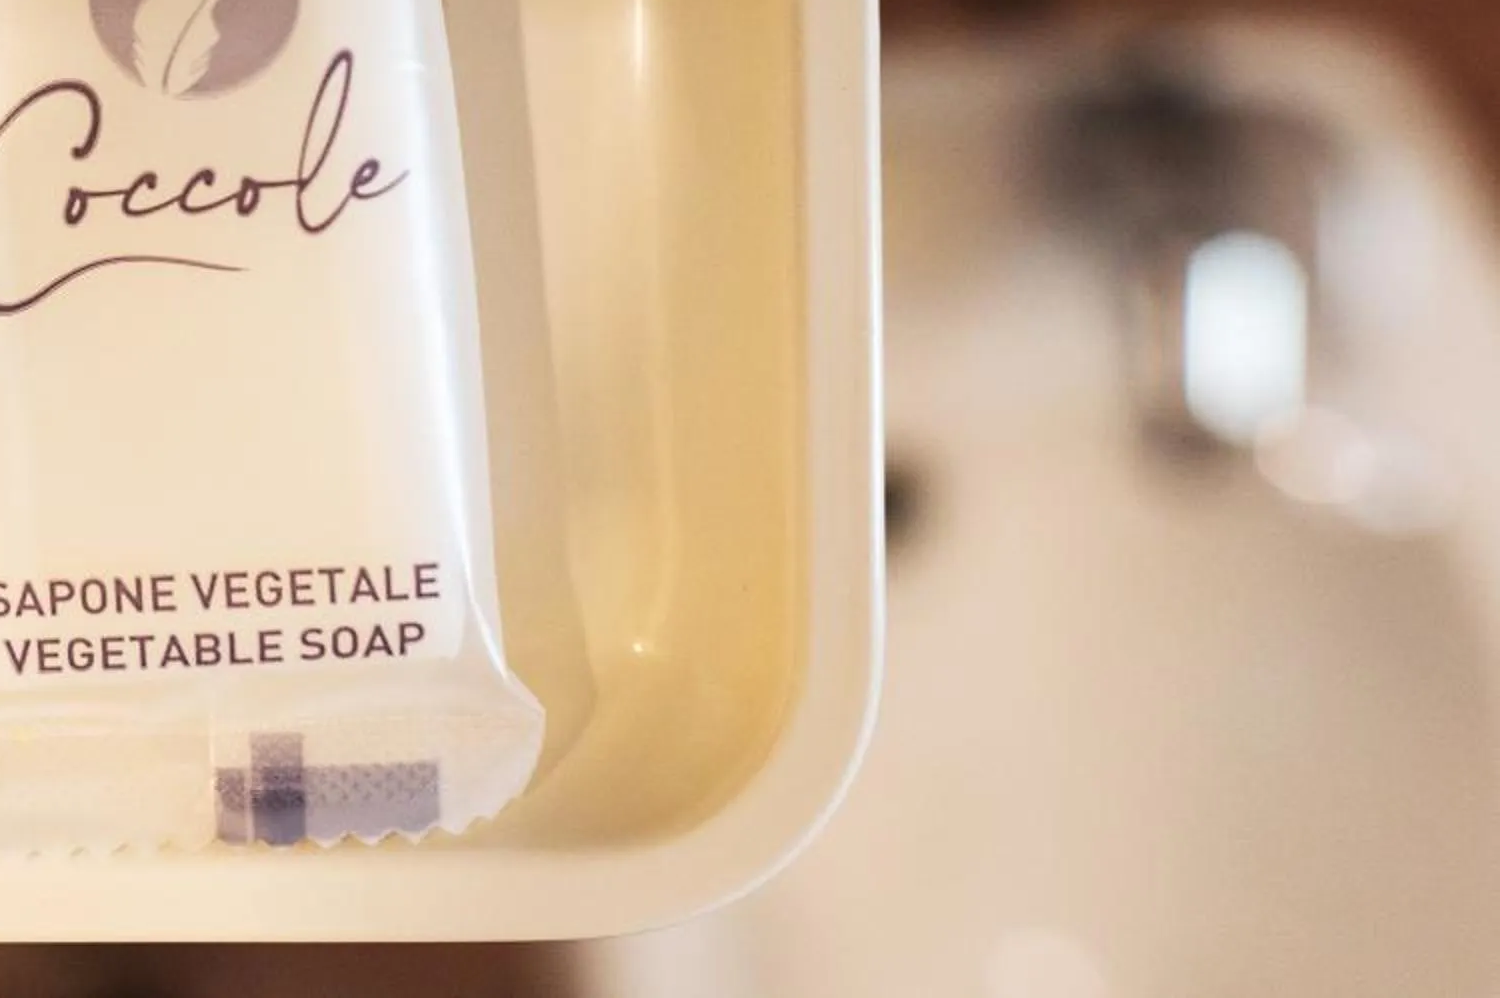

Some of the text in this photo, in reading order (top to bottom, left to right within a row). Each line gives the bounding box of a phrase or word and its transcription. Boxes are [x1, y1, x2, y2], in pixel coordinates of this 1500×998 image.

[189, 562, 441, 611] VEGETALE
[3, 622, 427, 675] VEGETABLE SOAP
